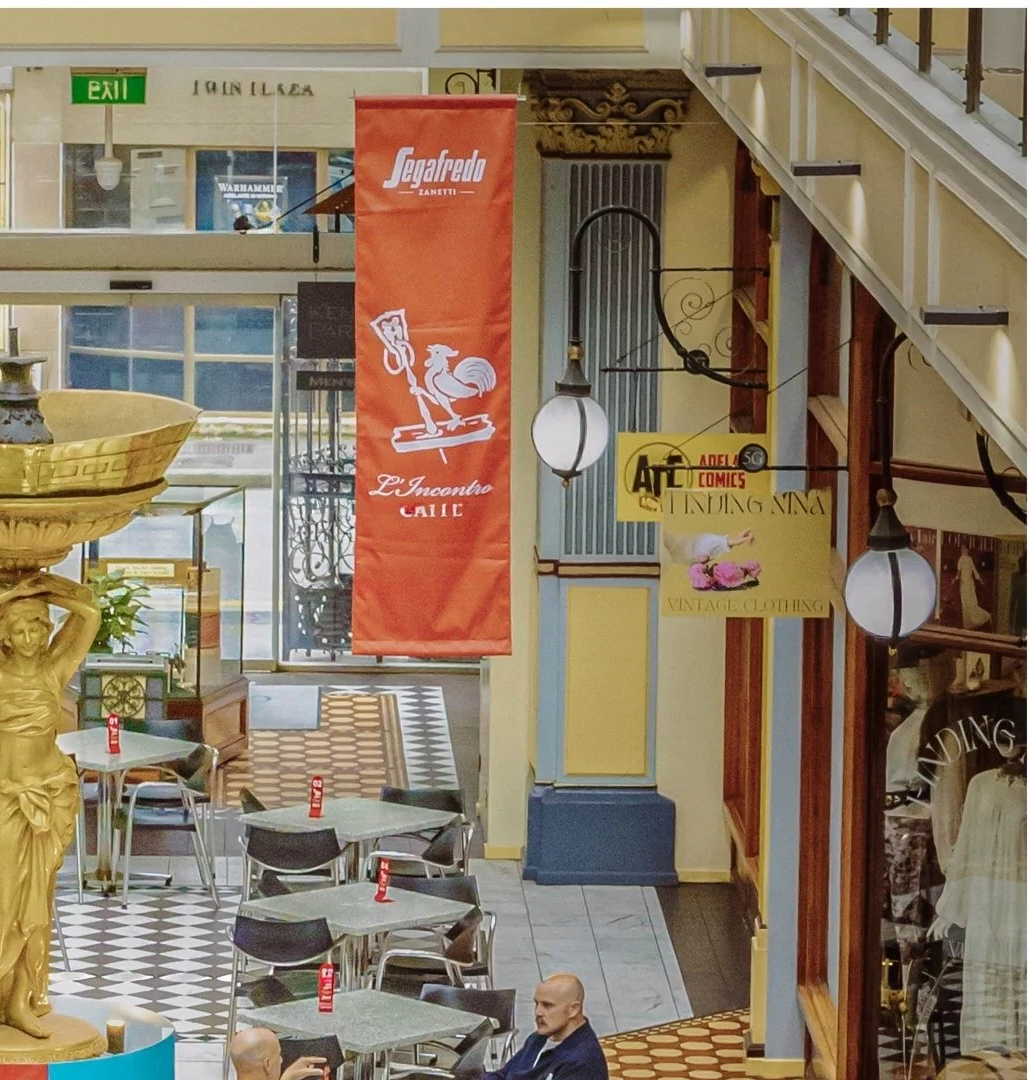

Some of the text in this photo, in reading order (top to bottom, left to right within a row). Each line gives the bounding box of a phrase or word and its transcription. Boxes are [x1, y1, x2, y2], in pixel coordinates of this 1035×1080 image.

[87, 78, 128, 101] EXIT
[382, 147, 487, 189] Segafredo
[418, 188, 457, 196] ZANETTI
[699, 453, 740, 468] ADELA
[368, 473, 494, 498] L'Incontro
[698, 471, 746, 489] COMICS
[669, 491, 828, 516] FINDING NINA
[667, 597, 824, 614] VINTAGE CLOTHING
